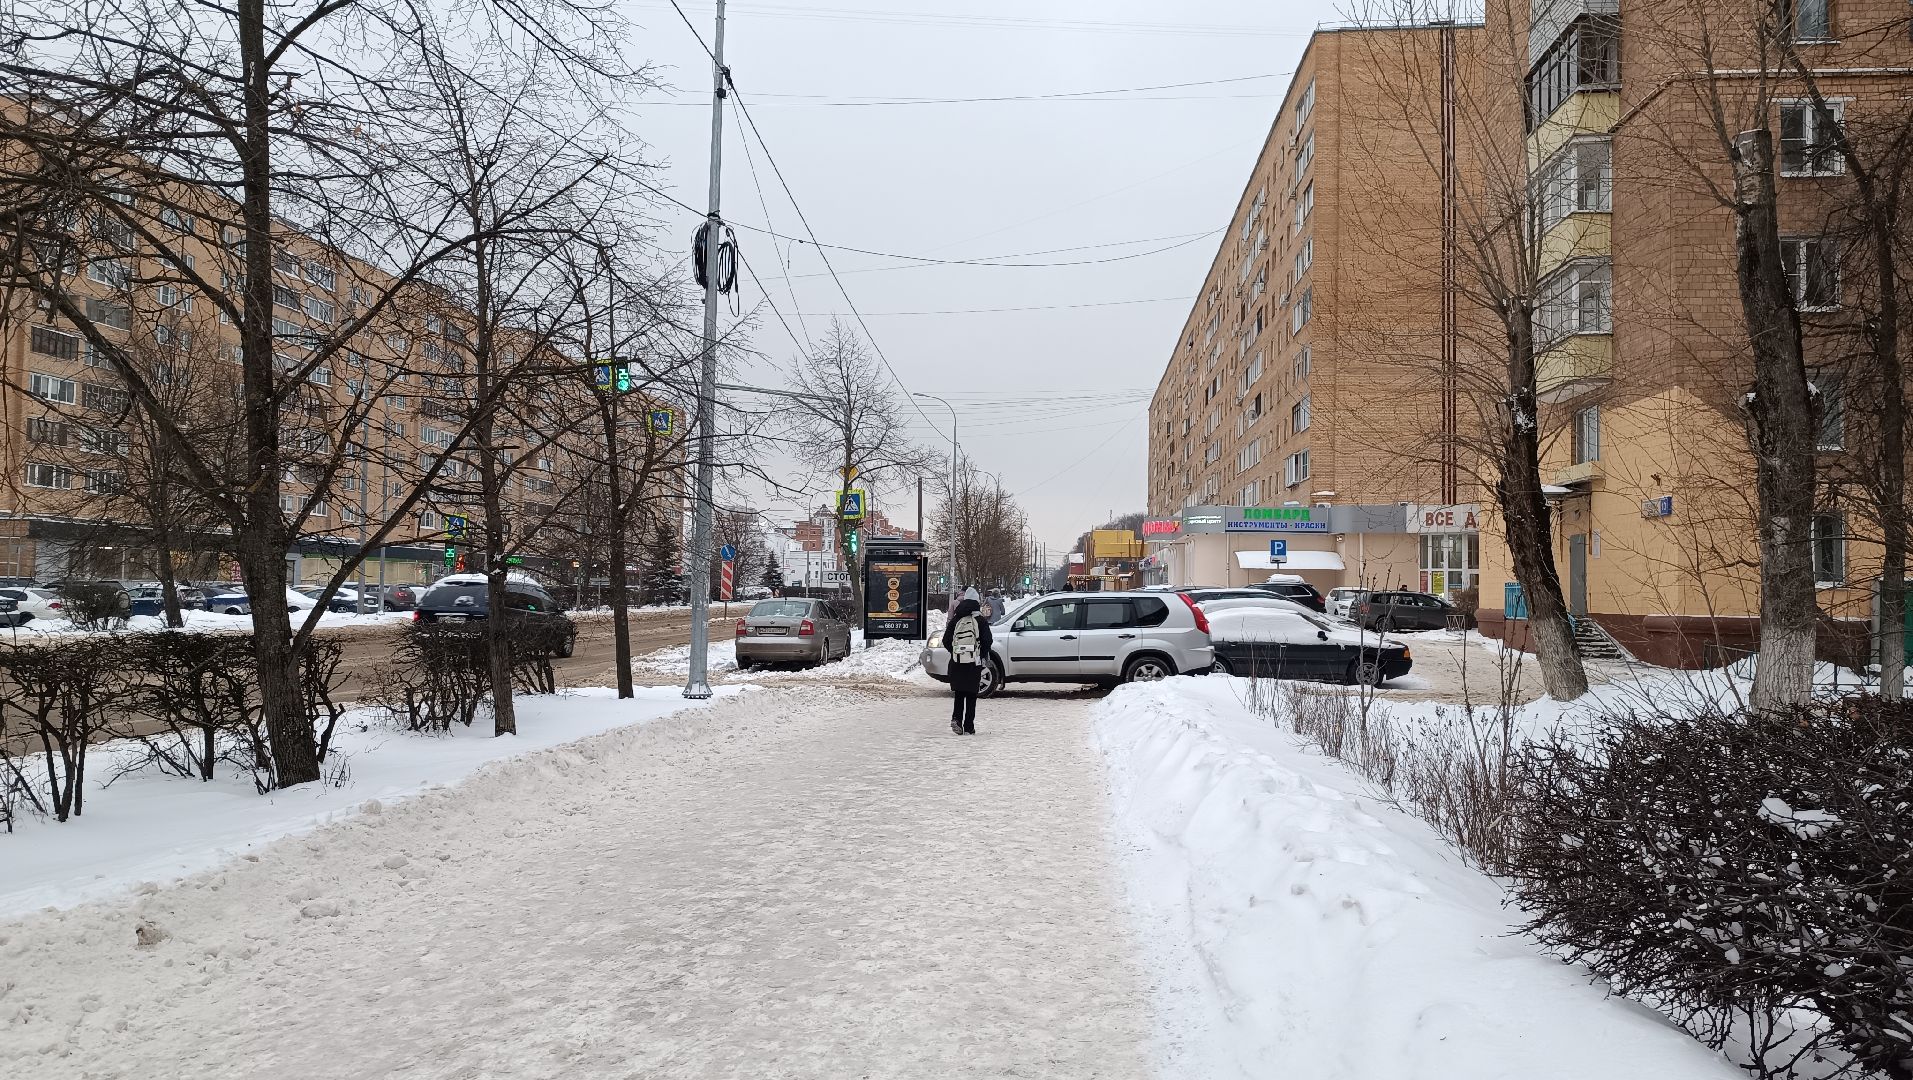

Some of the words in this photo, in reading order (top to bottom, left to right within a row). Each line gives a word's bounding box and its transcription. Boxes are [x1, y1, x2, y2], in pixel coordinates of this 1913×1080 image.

[1243, 508, 1311, 521] ЛОМБАРД
[1425, 511, 1454, 527] ВСЕ
[1464, 511, 1479, 529] Д
[1227, 521, 1288, 529] ИНСТРУМЕНТЫ
[827, 572, 852, 581] СТОП
